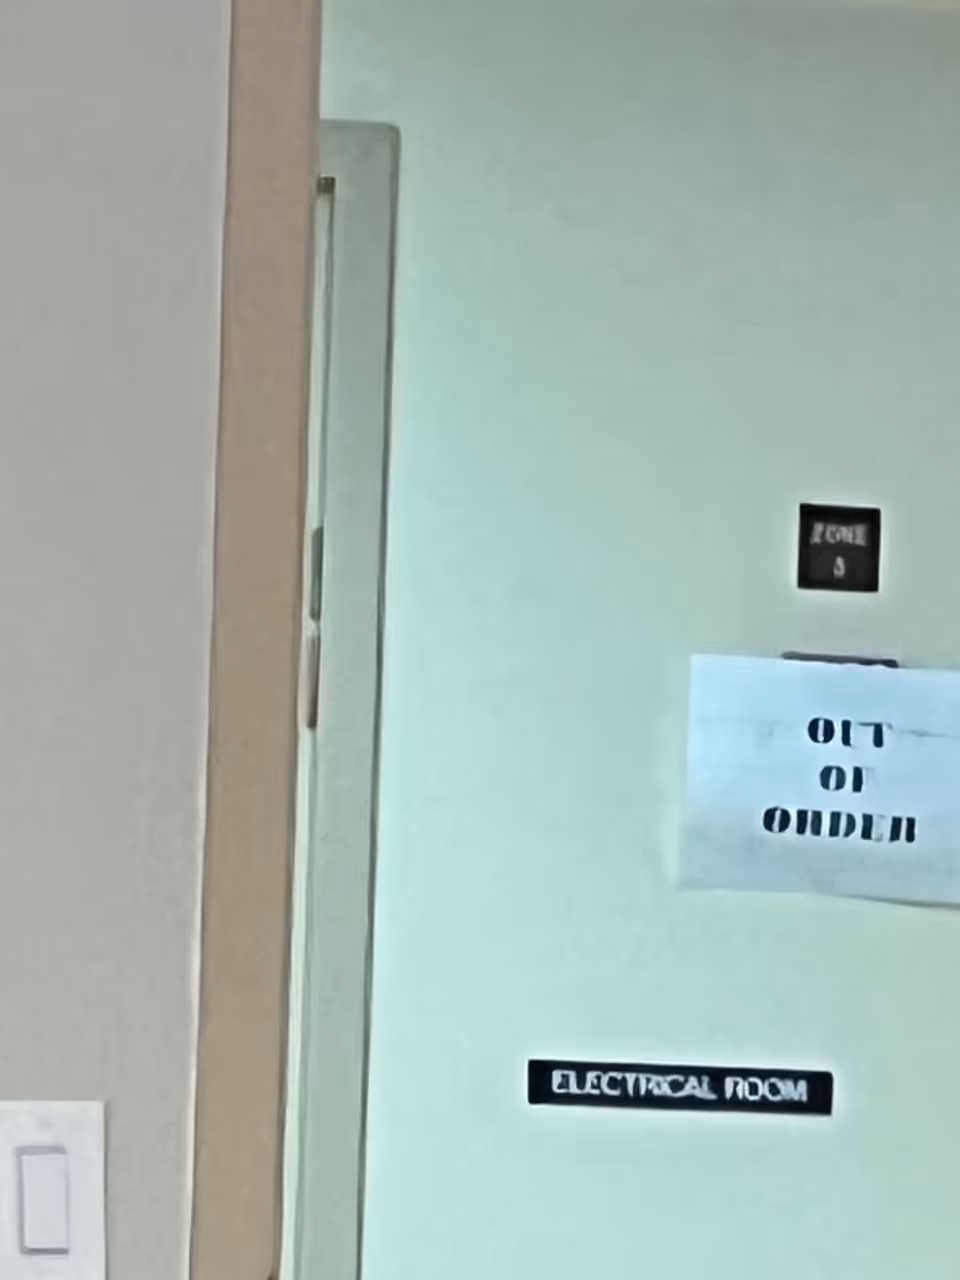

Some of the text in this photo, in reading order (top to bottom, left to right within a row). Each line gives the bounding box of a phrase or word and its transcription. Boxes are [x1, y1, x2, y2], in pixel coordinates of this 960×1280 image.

[808, 717, 893, 748] OUT
[820, 765, 872, 793] OF
[762, 806, 916, 844] ORDER
[551, 1069, 808, 1103] ELECTRICAL ROOM
